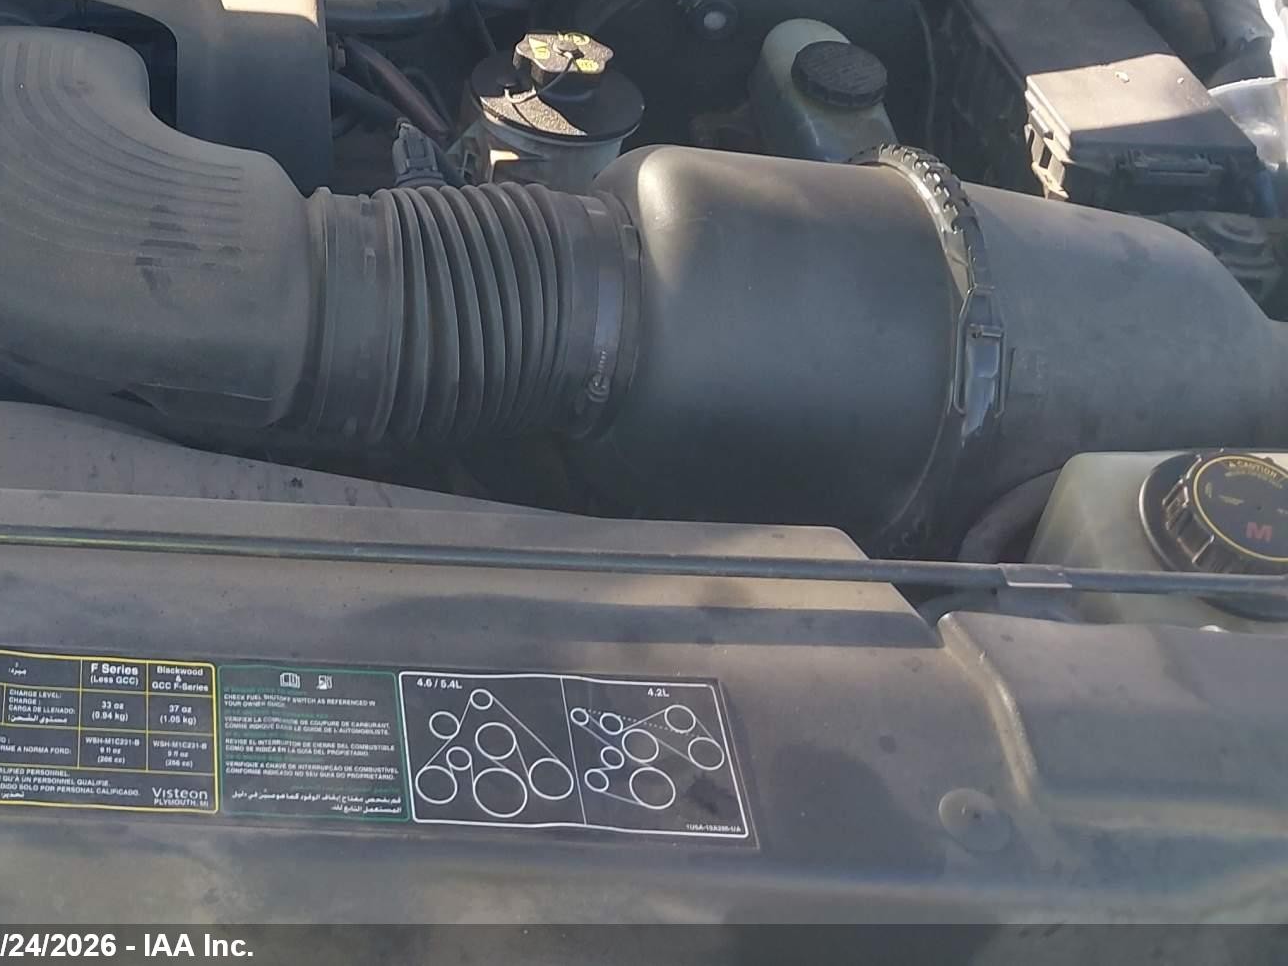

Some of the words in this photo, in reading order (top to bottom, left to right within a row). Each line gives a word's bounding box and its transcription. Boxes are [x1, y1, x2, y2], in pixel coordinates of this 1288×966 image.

[91, 662, 99, 673] F
[101, 662, 139, 676] Series
[156, 665, 204, 676] Blackwood
[90, 674, 114, 684] (Less
[115, 675, 139, 686] GCC)
[175, 674, 182, 683] &
[151, 681, 172, 690] GCC
[173, 682, 209, 692] F-Series
[440, 679, 463, 690] 5.4L
[8, 689, 37, 697] CHARGE
[647, 687, 670, 698] 4.2L
[8, 697, 37, 705] CHARGE
[223, 693, 246, 701] CHECK
[326, 698, 368, 706] REFERENCED
[8, 704, 31, 712] CARGA
[101, 700, 112, 710] 33
[113, 702, 125, 711] oz
[168, 704, 180, 713] 37
[181, 705, 192, 714] oz
[114, 711, 129, 722] kg)
[159, 713, 181, 724] (1.05
[182, 715, 197, 725] kg)
[23, 745, 49, 754] NORMA
[40, 784, 55, 792] POR
[56, 785, 94, 794] PERSONAL
[151, 786, 209, 800] Visteon
[199, 799, 209, 807] MI
